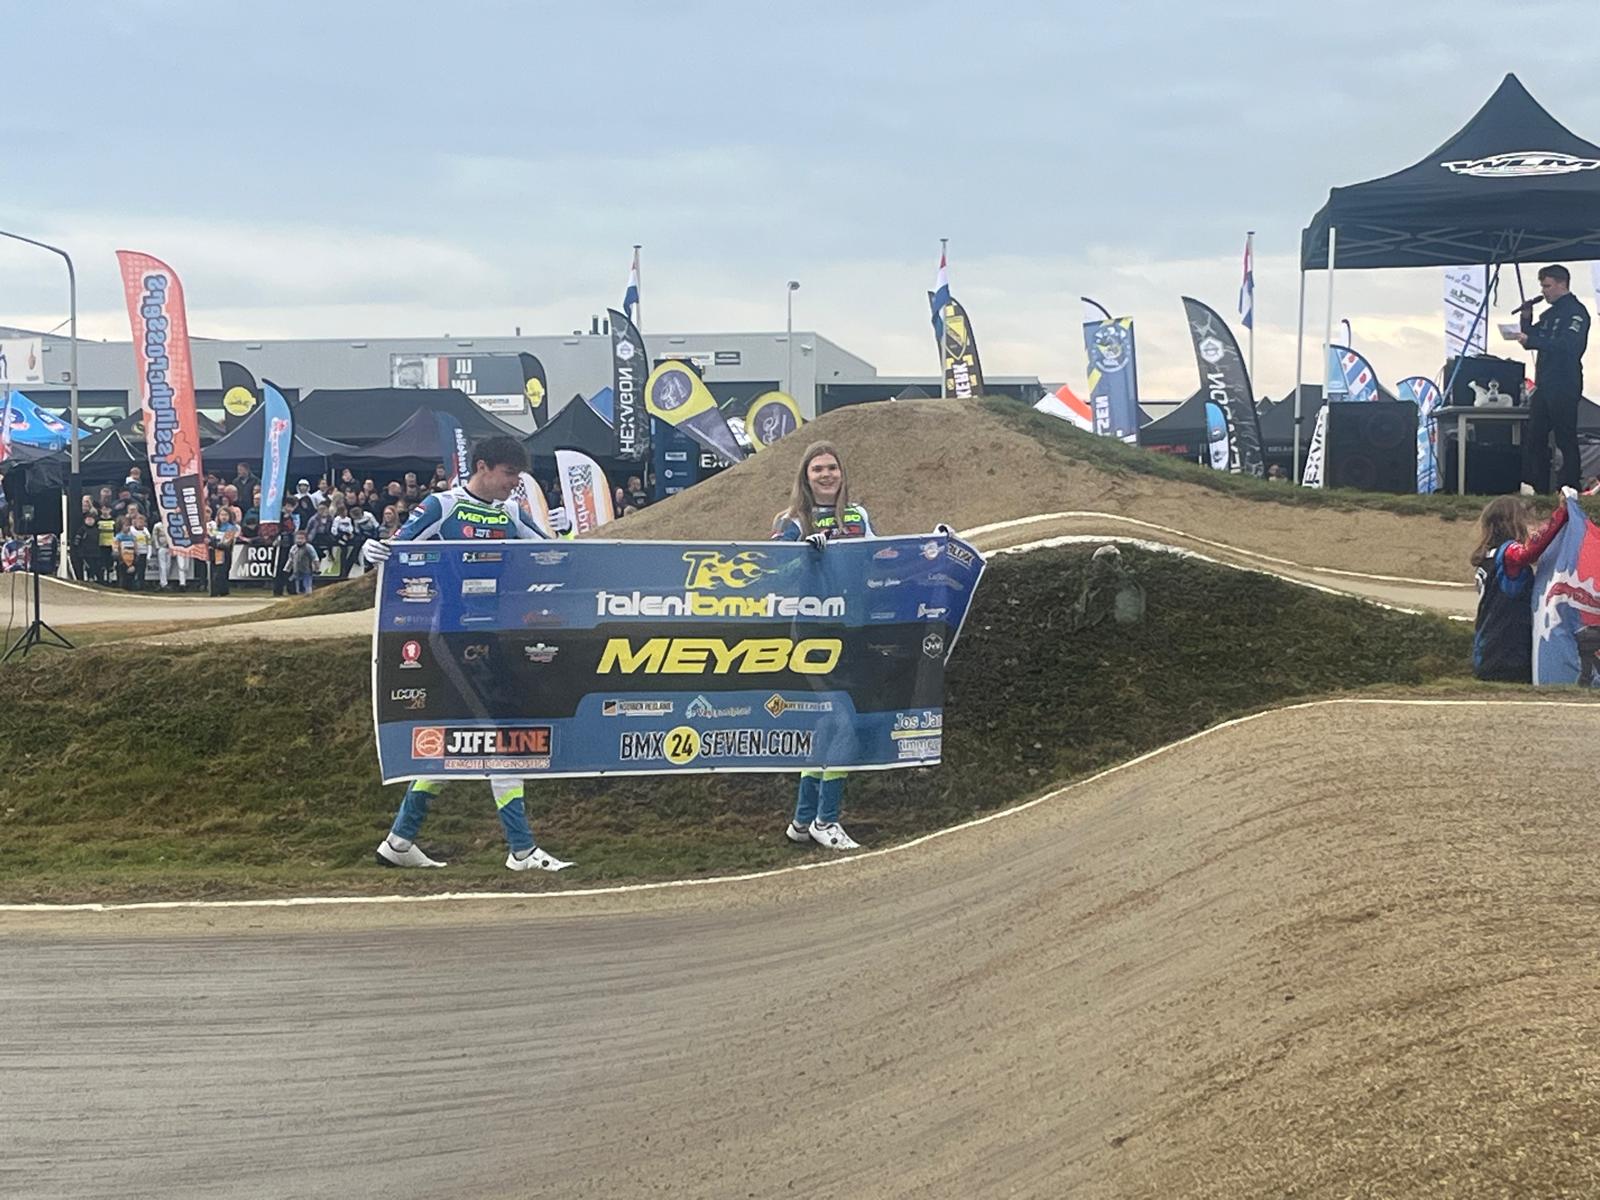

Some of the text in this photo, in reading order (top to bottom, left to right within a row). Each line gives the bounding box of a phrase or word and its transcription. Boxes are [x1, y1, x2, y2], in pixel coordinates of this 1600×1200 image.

[457, 511, 509, 525] MEYBO
[814, 514, 862, 528] MEBO
[596, 590, 846, 617] talentbmxteam
[597, 638, 843, 675] MEYBO
[894, 713, 918, 730] Jos
[446, 730, 549, 754] JIFELINE
